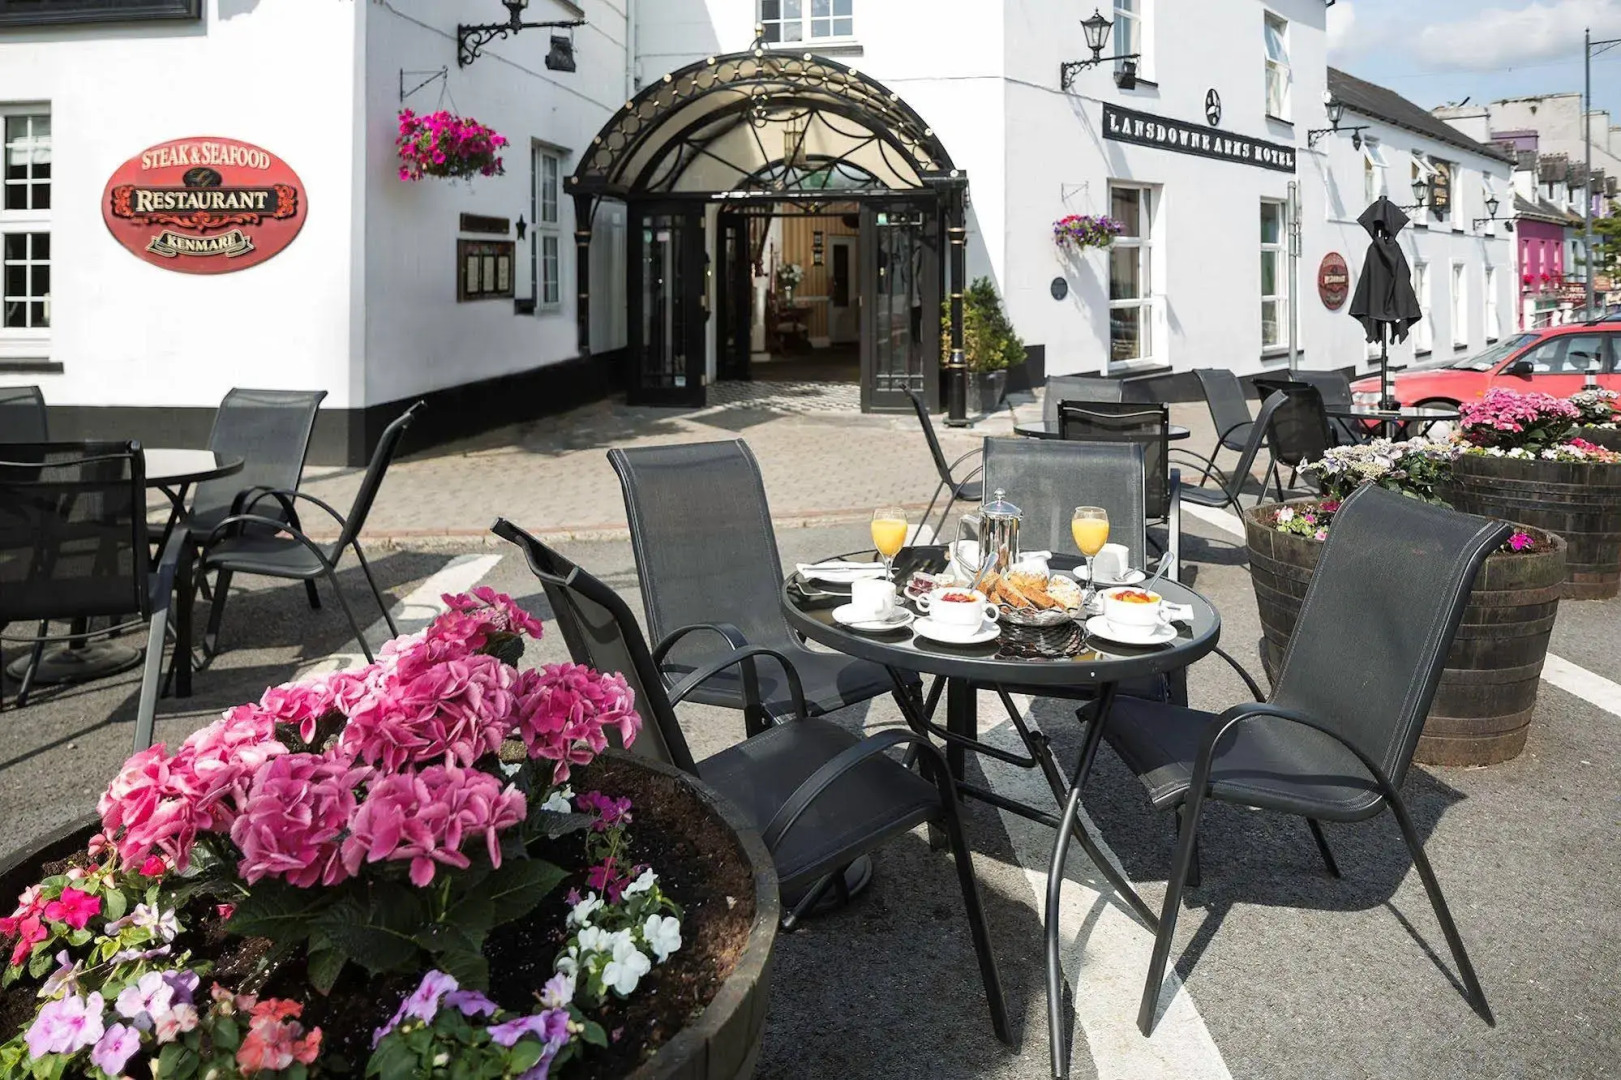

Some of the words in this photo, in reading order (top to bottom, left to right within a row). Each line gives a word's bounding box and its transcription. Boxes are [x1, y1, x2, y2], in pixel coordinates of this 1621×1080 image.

[1109, 113, 1210, 151] LANSDOWNE
[1213, 137, 1250, 158] ARMS
[1254, 145, 1294, 167] HOTEL
[141, 144, 189, 170] STEAK
[200, 142, 271, 170] SEAFOOD
[135, 190, 269, 212] RESTAURANT
[166, 233, 238, 253] KENMARE
